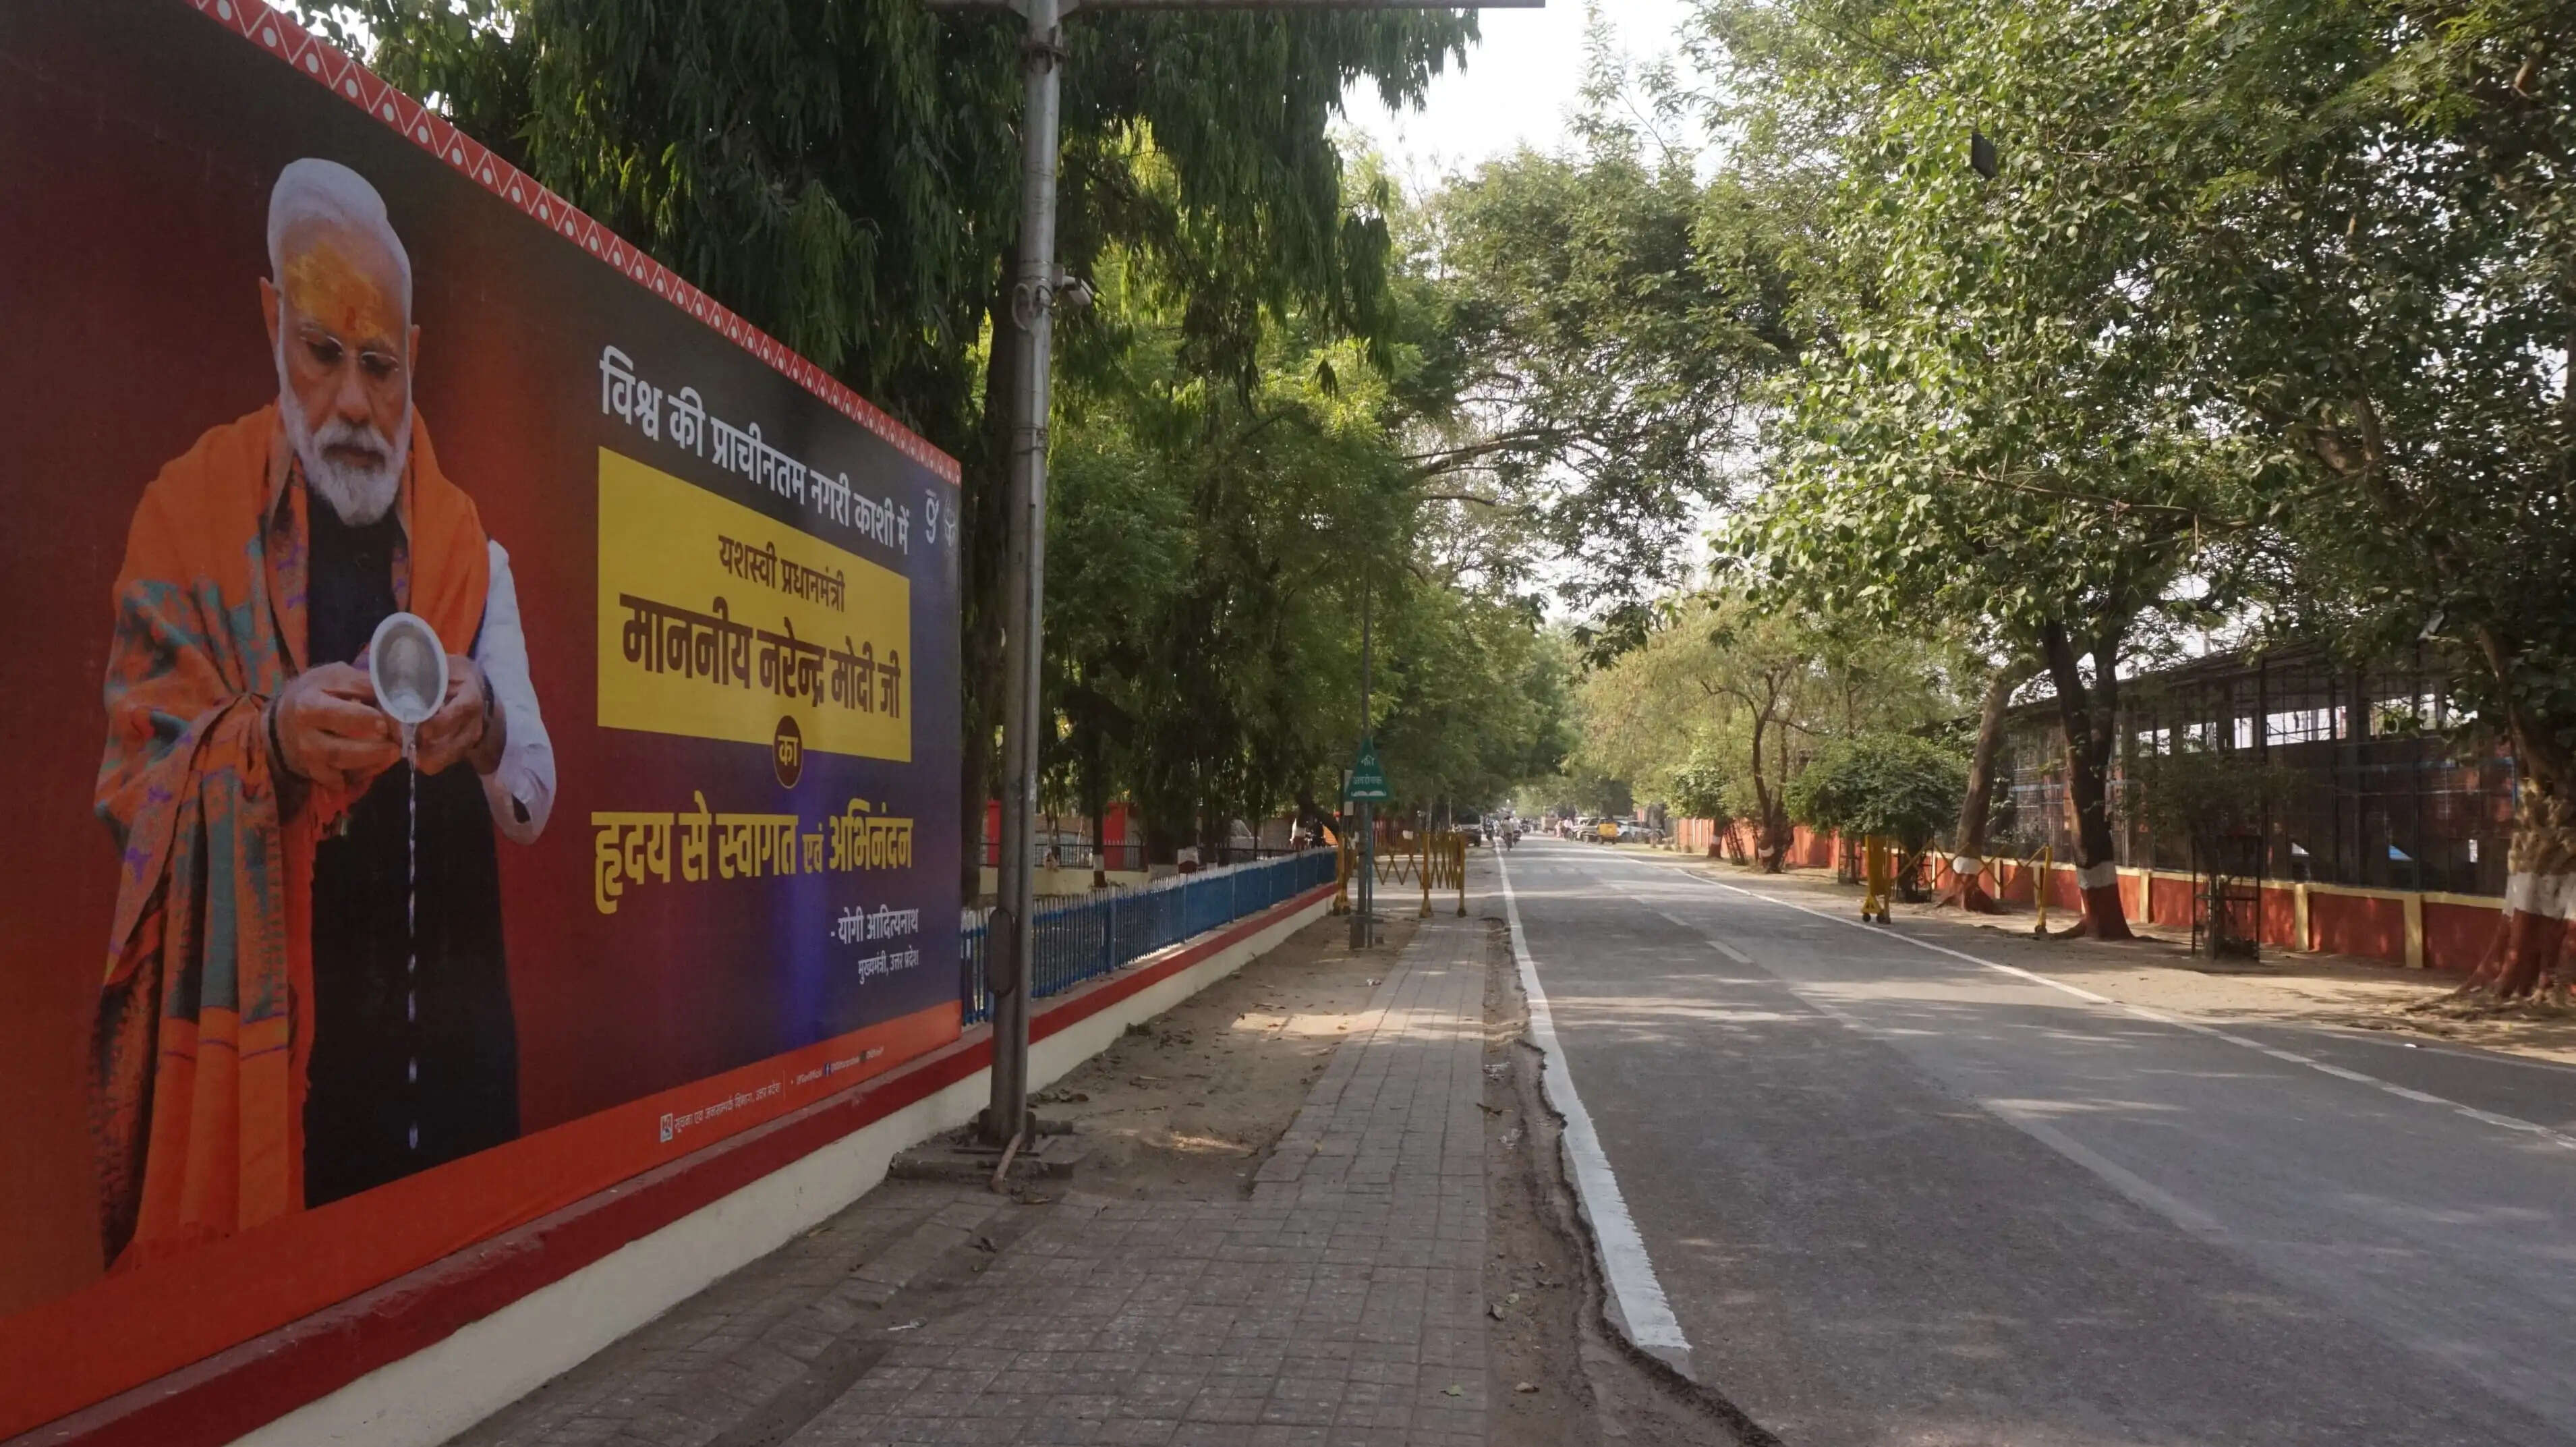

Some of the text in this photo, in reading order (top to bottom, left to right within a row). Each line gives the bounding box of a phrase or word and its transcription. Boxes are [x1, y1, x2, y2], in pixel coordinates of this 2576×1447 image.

[599, 345, 662, 441] विश्व
[668, 386, 704, 457] की
[710, 422, 806, 505] प्राचीनतम
[811, 468, 851, 527] नगरी
[854, 492, 895, 548] काशी
[896, 505, 910, 555] में
[718, 534, 846, 613] यशस्वी प्रधानमंत्री
[619, 592, 900, 718] माननीय नरेन्द्र मोदी जी
[778, 736, 798, 768] का
[592, 790, 914, 914] हृदय से स्वागत एवं अभिनंदन
[838, 905, 864, 944] योगी
[866, 903, 919, 940] आदित्यनाथ
[890, 952, 903, 971] उत्तर
[905, 944, 919, 968] प्रदेश
